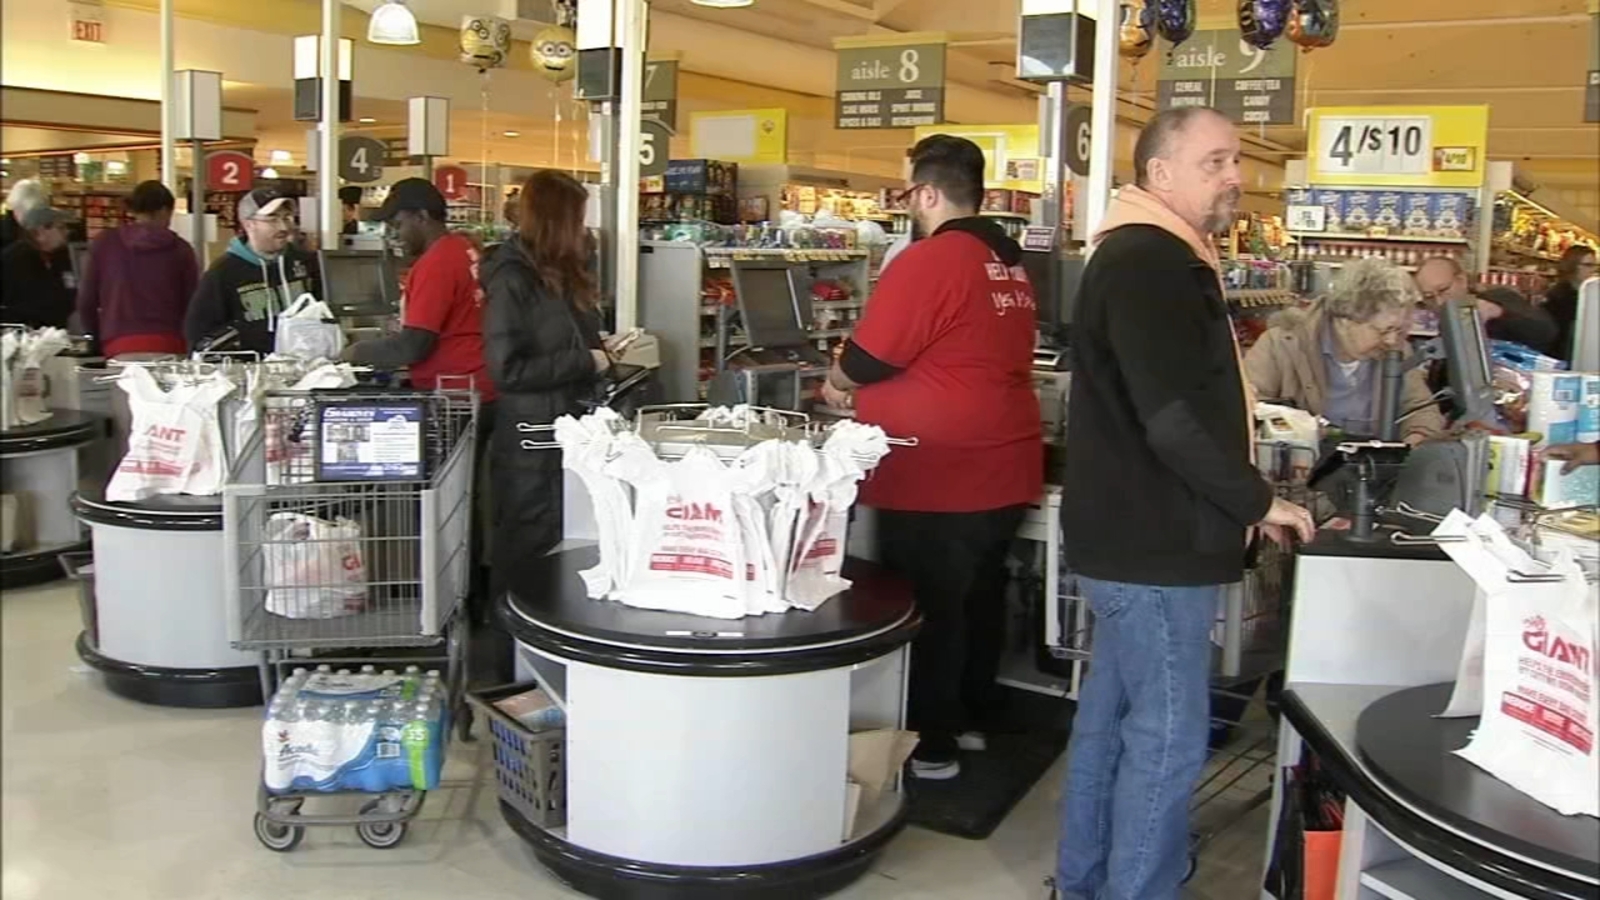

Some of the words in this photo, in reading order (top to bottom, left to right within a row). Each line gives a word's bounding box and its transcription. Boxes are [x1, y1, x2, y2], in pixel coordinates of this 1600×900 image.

[75, 20, 102, 41] EXIT
[851, 60, 889, 80] aisle
[899, 49, 919, 82] 8
[1176, 45, 1226, 68] aisle
[639, 132, 655, 166] 5
[1077, 121, 1091, 161] 6
[1329, 124, 1422, 167] 4/$10
[222, 162, 240, 184] 2
[351, 147, 369, 174] 4
[445, 174, 455, 193] 1
[143, 424, 186, 442] ANT
